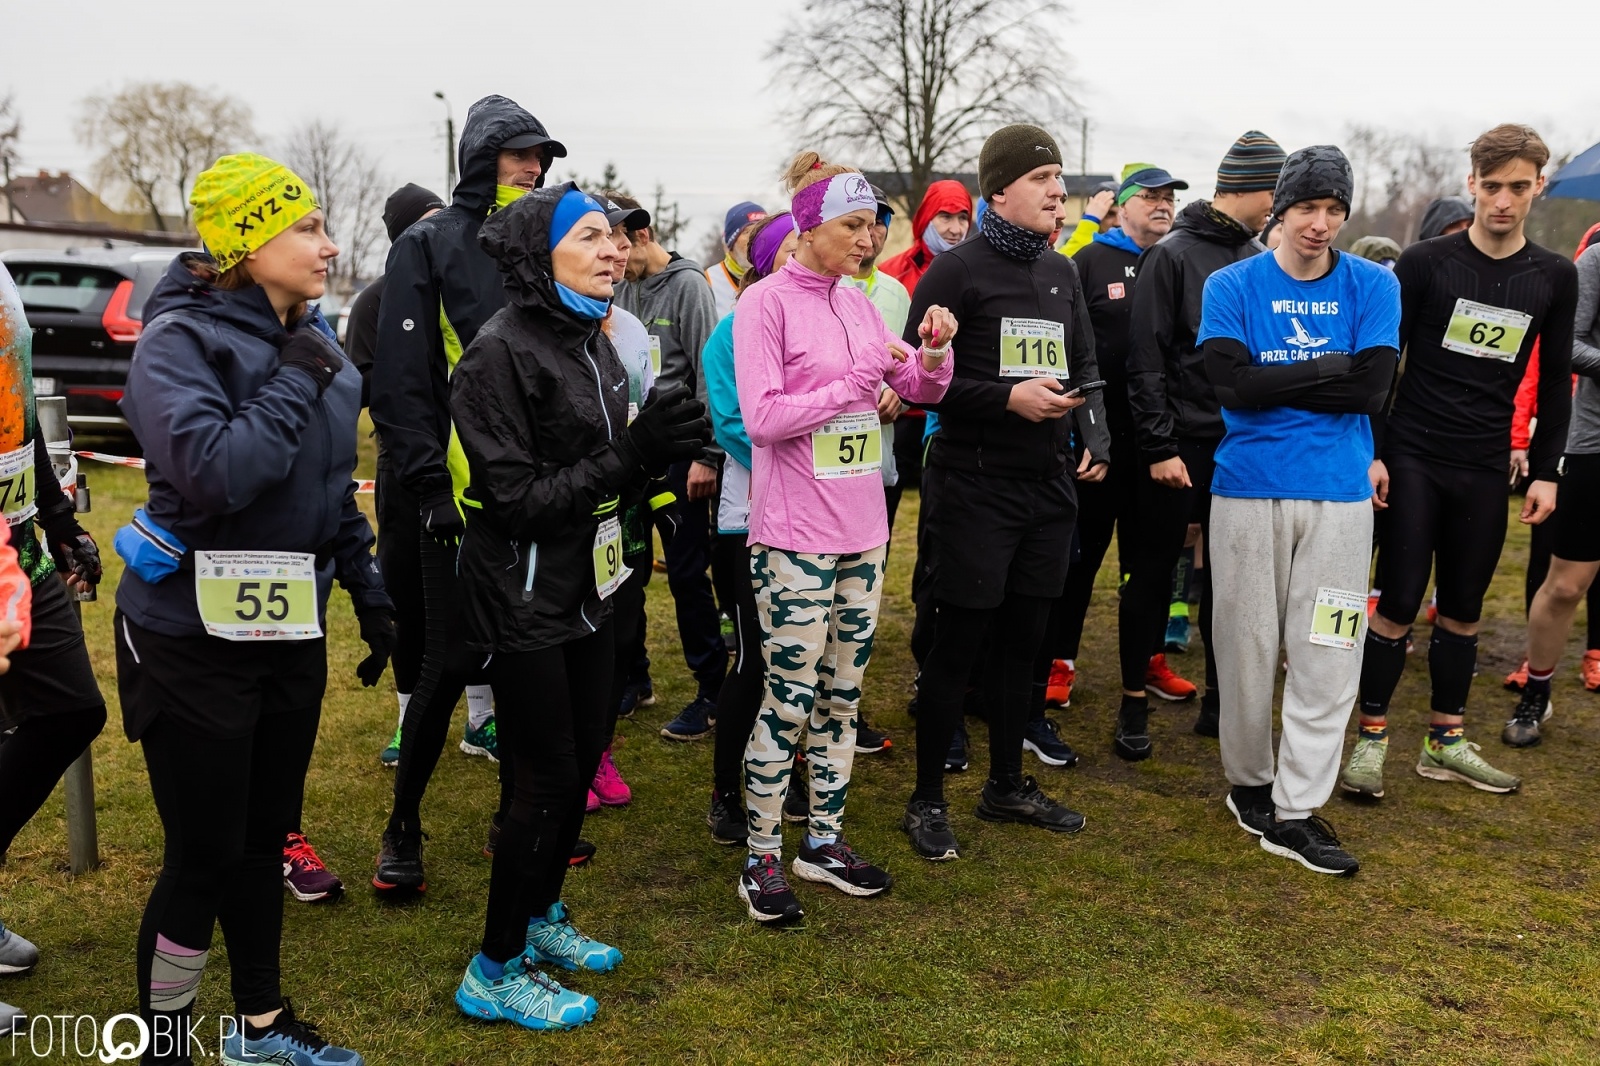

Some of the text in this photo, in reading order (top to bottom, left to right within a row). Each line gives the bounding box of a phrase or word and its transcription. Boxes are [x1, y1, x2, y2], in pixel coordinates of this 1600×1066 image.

[228, 175, 289, 217] fabryka aktywności
[234, 197, 282, 236] XYZ
[1272, 299, 1339, 315] WIELKI REJS
[1469, 322, 1506, 349] 62
[1016, 338, 1057, 366] 116
[838, 434, 868, 464] 57
[235, 582, 289, 621] 55
[1330, 609, 1360, 637] 11
